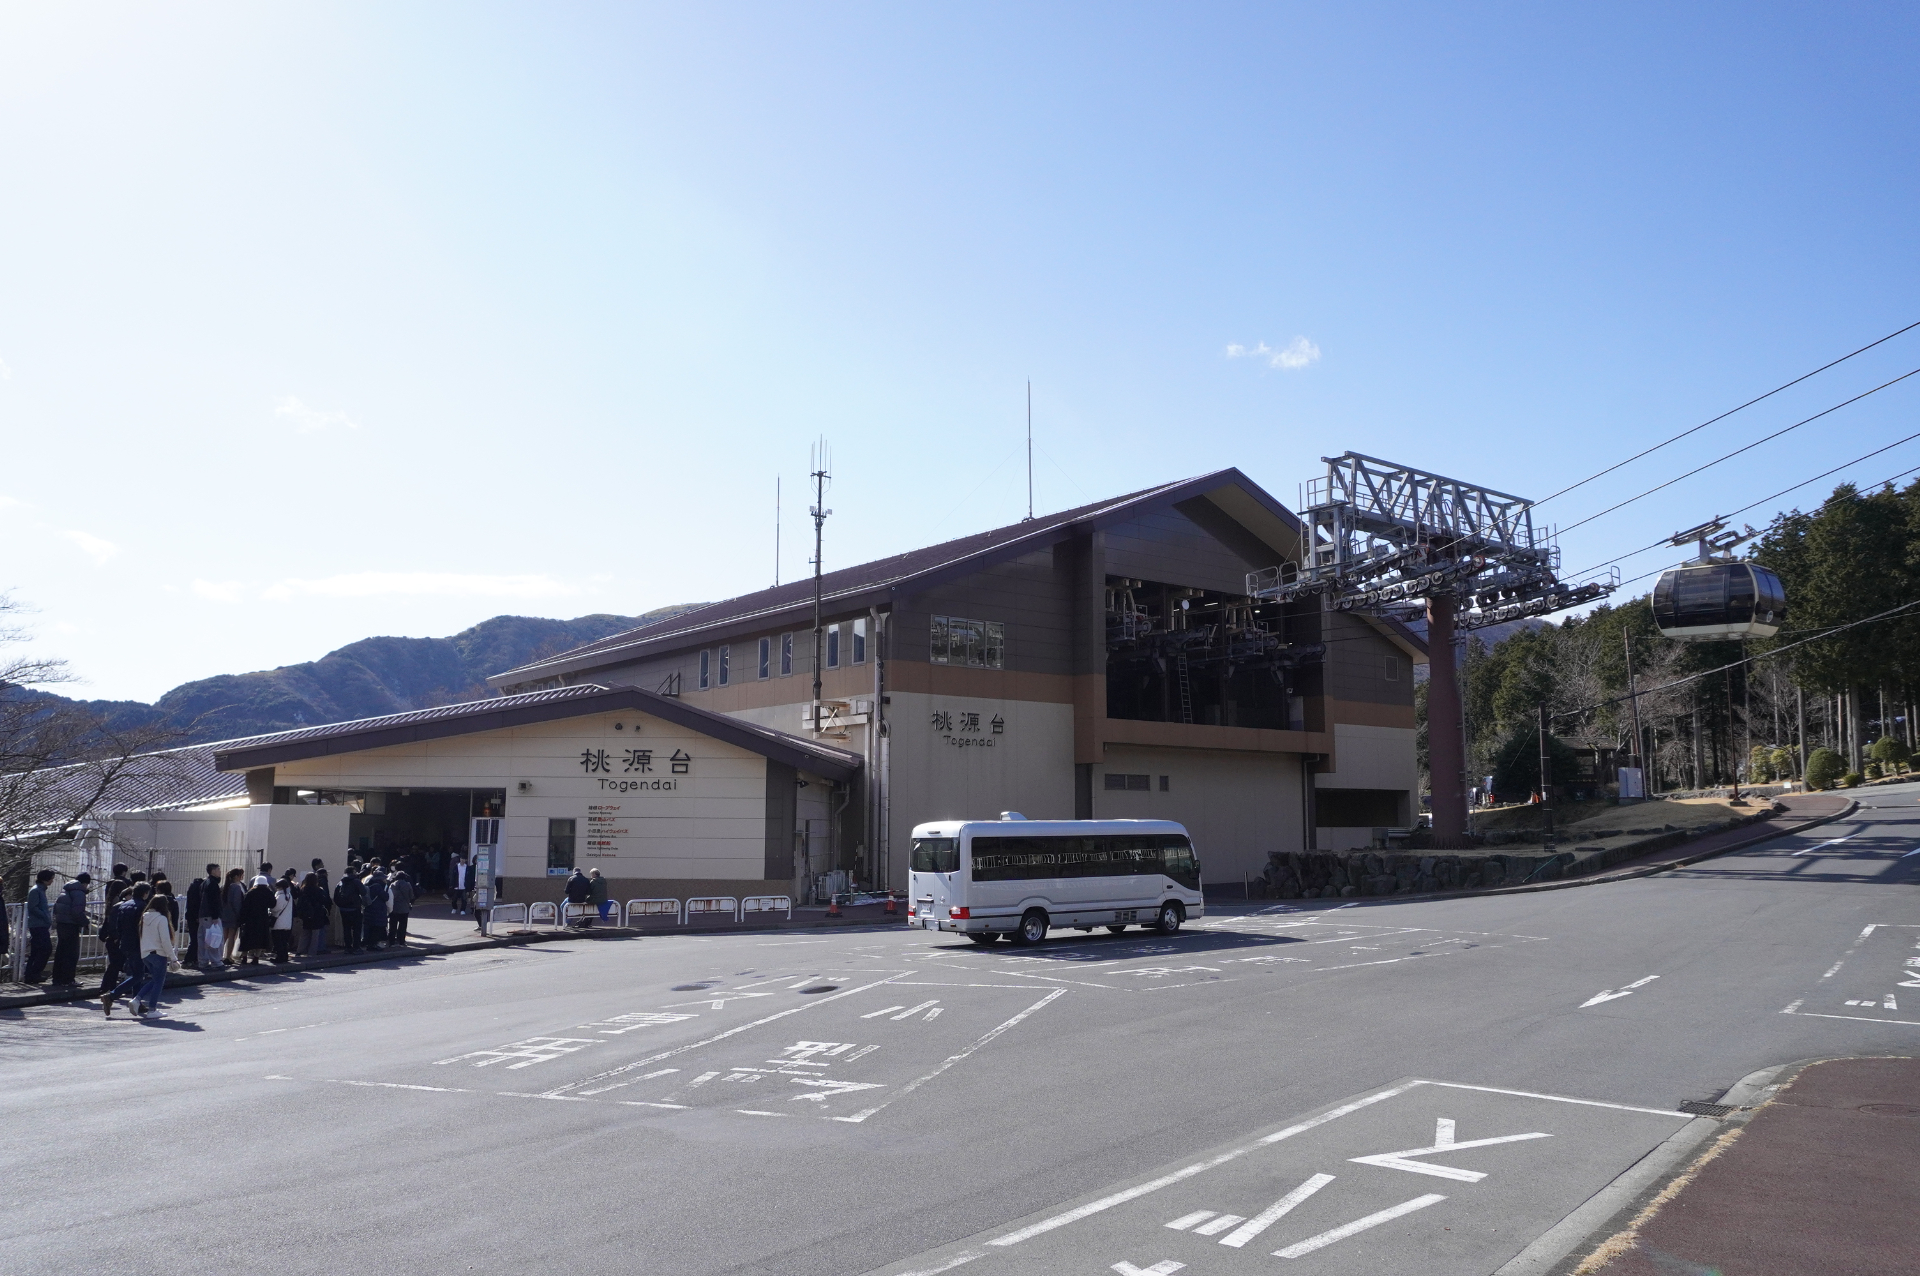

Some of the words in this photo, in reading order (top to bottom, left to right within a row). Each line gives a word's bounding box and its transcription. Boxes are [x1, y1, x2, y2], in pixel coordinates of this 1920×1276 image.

[931, 709, 1005, 734] 桃源台
[943, 735, 997, 748] Togendai
[580, 748, 692, 774] 桃源台
[597, 778, 678, 792] Togendai
